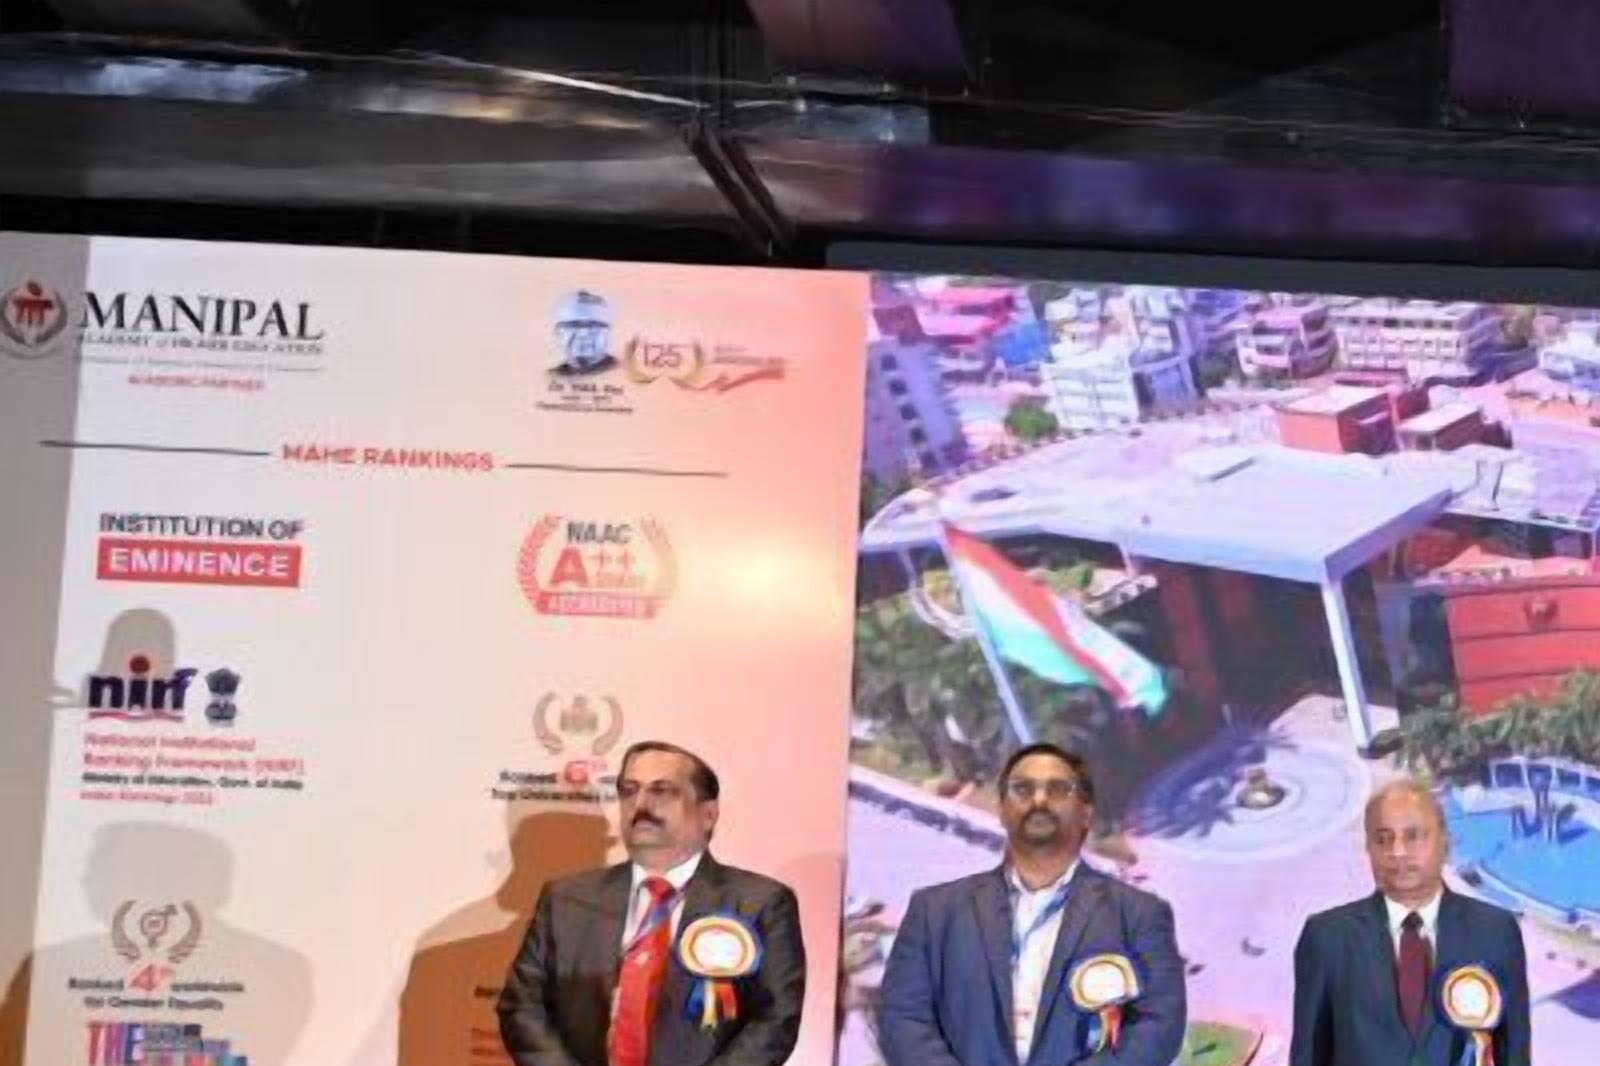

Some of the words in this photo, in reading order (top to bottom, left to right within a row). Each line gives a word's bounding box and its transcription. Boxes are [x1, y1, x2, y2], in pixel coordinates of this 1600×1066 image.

[79, 291, 323, 340] MANIPAL
[283, 445, 356, 465] MAHE
[362, 448, 493, 471] RANKINGS
[99, 512, 264, 537] INSTITUTION
[268, 518, 304, 541] OF
[567, 522, 632, 544] NAAC
[110, 548, 290, 578] EMINENCE
[88, 656, 198, 711] nirf
